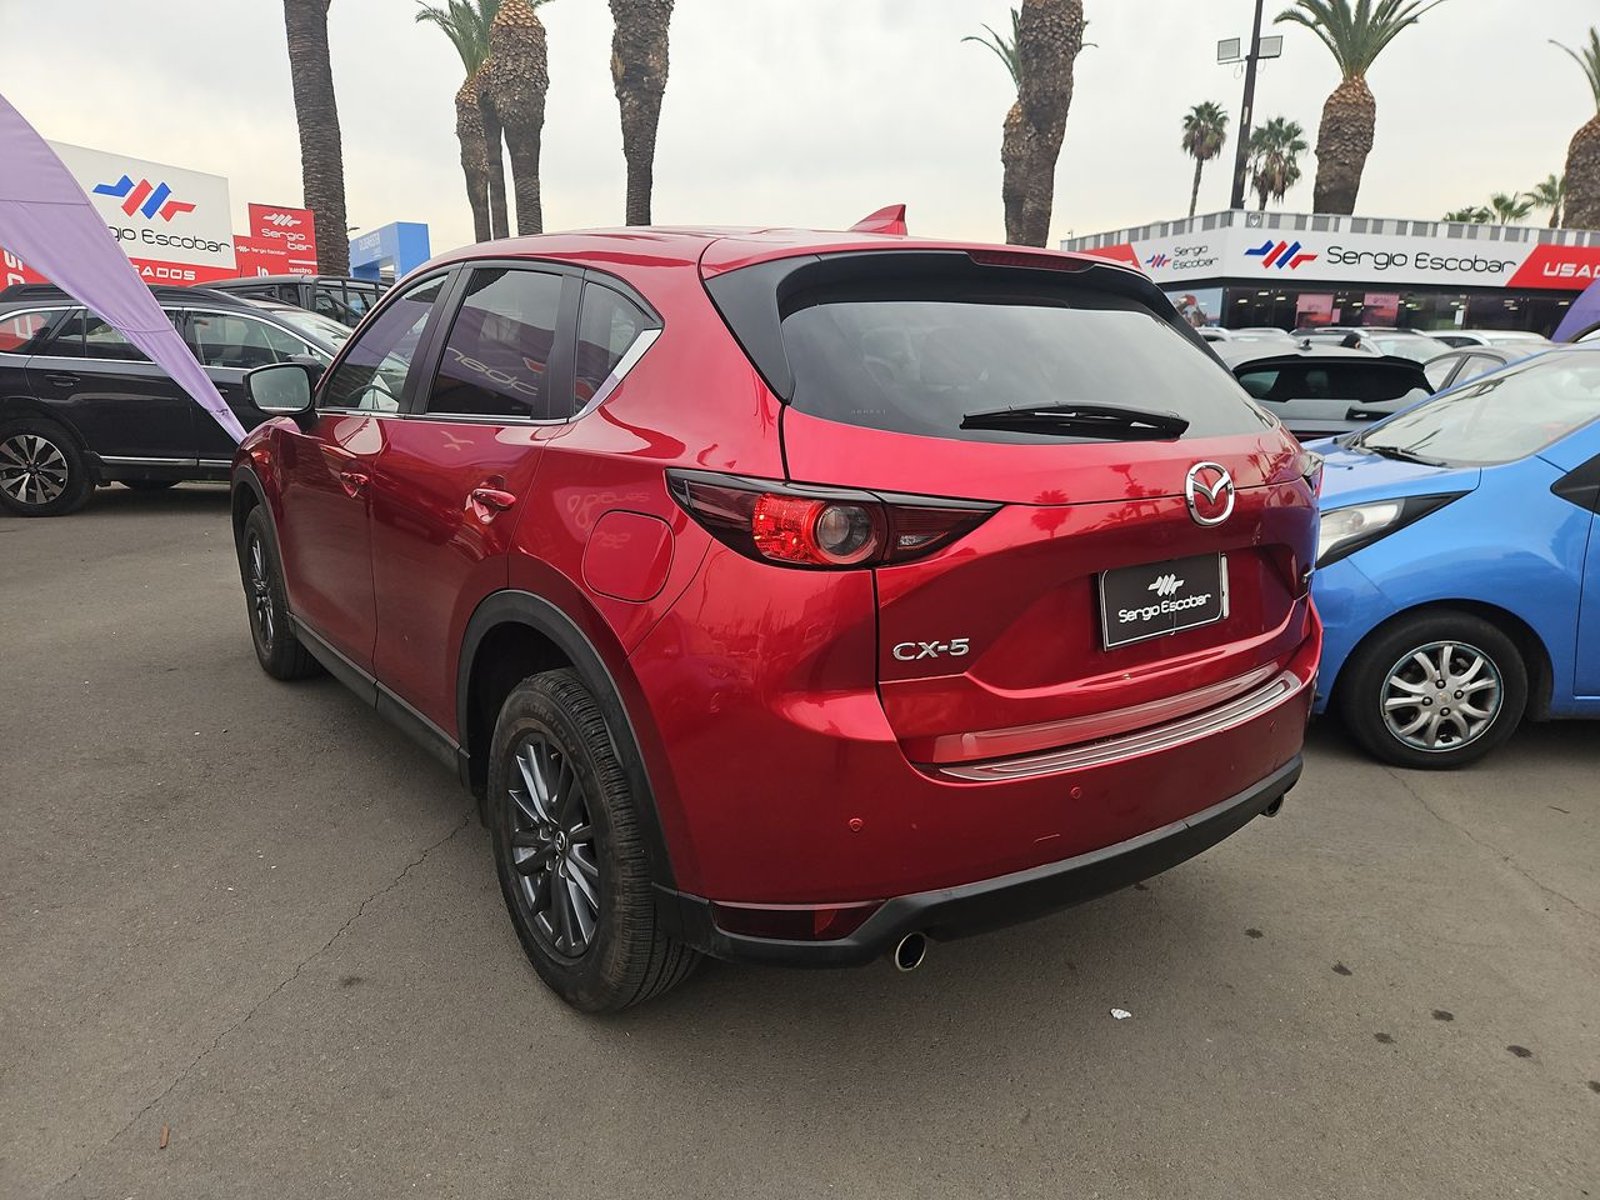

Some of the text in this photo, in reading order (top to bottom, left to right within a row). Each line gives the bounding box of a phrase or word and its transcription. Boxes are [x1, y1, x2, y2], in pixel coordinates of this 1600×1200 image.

[141, 228, 230, 252] Escobar
[1327, 246, 1516, 273] Sergio Escobar
[1118, 593, 1212, 623] Sergio Escobar
[893, 638, 970, 660] CX-5
